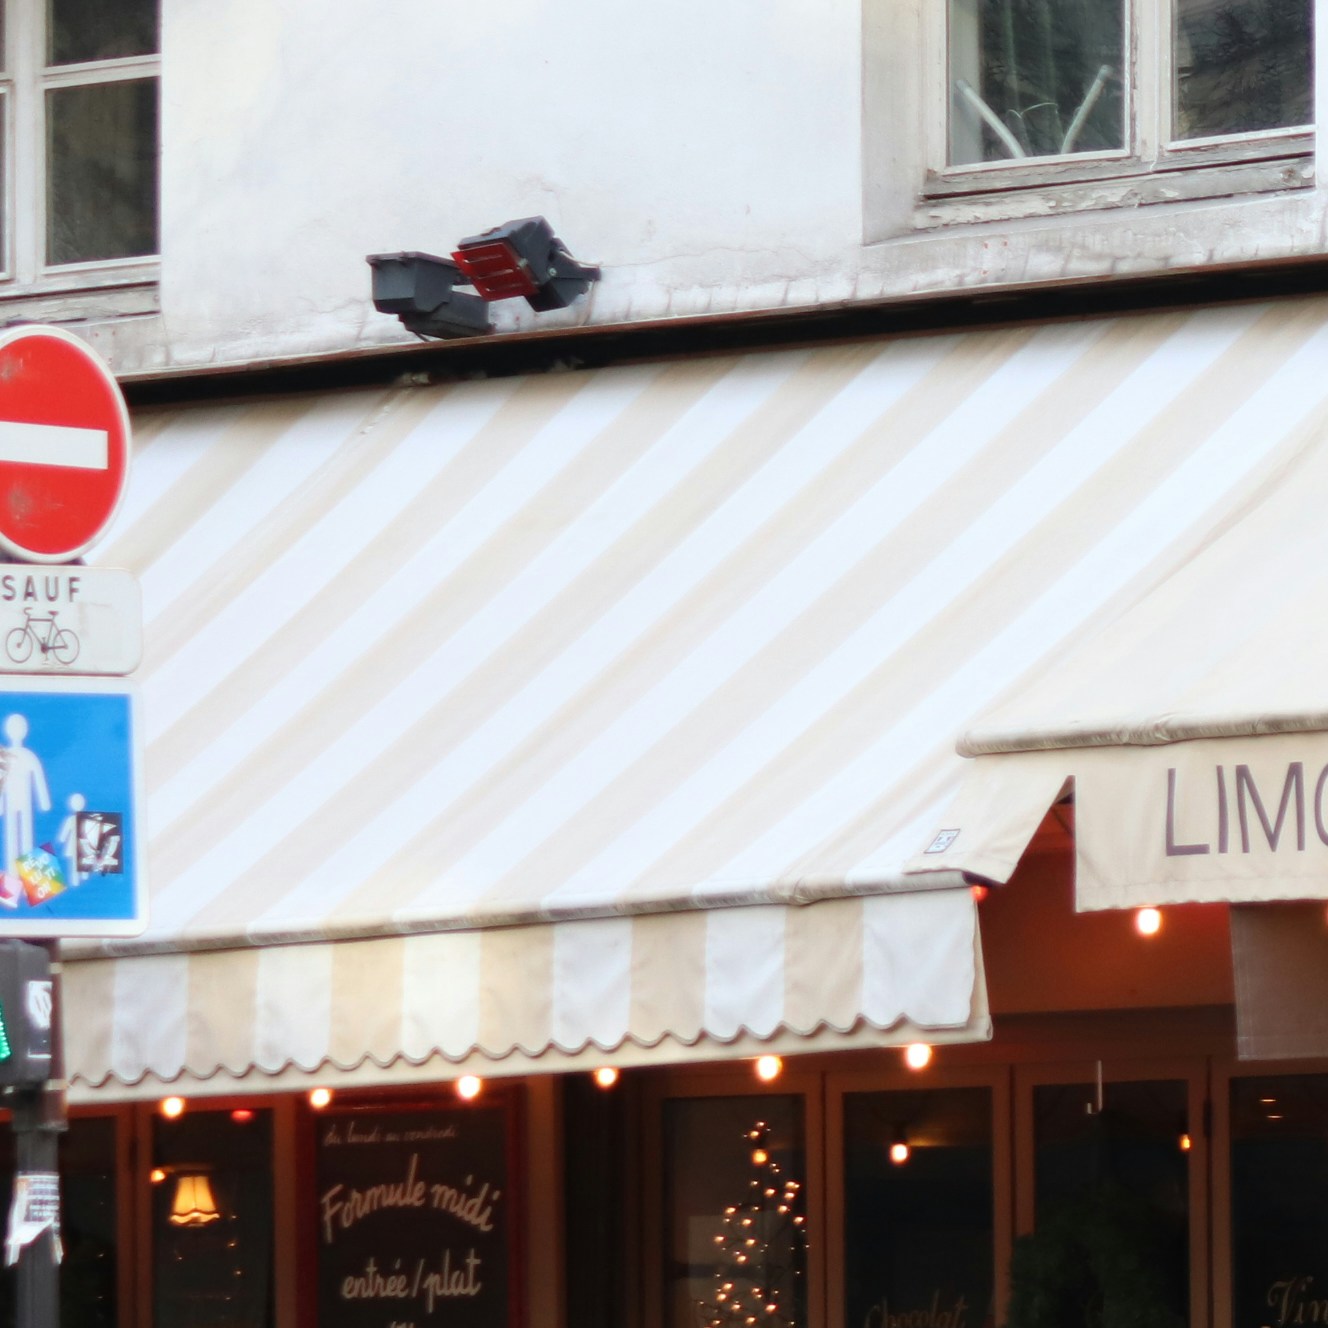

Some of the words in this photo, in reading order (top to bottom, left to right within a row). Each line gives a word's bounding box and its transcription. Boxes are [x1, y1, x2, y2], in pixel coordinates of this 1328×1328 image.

[1, 575, 81, 602] SAUF
[320, 1152, 426, 1244] Formule
[430, 1174, 501, 1232] midi
